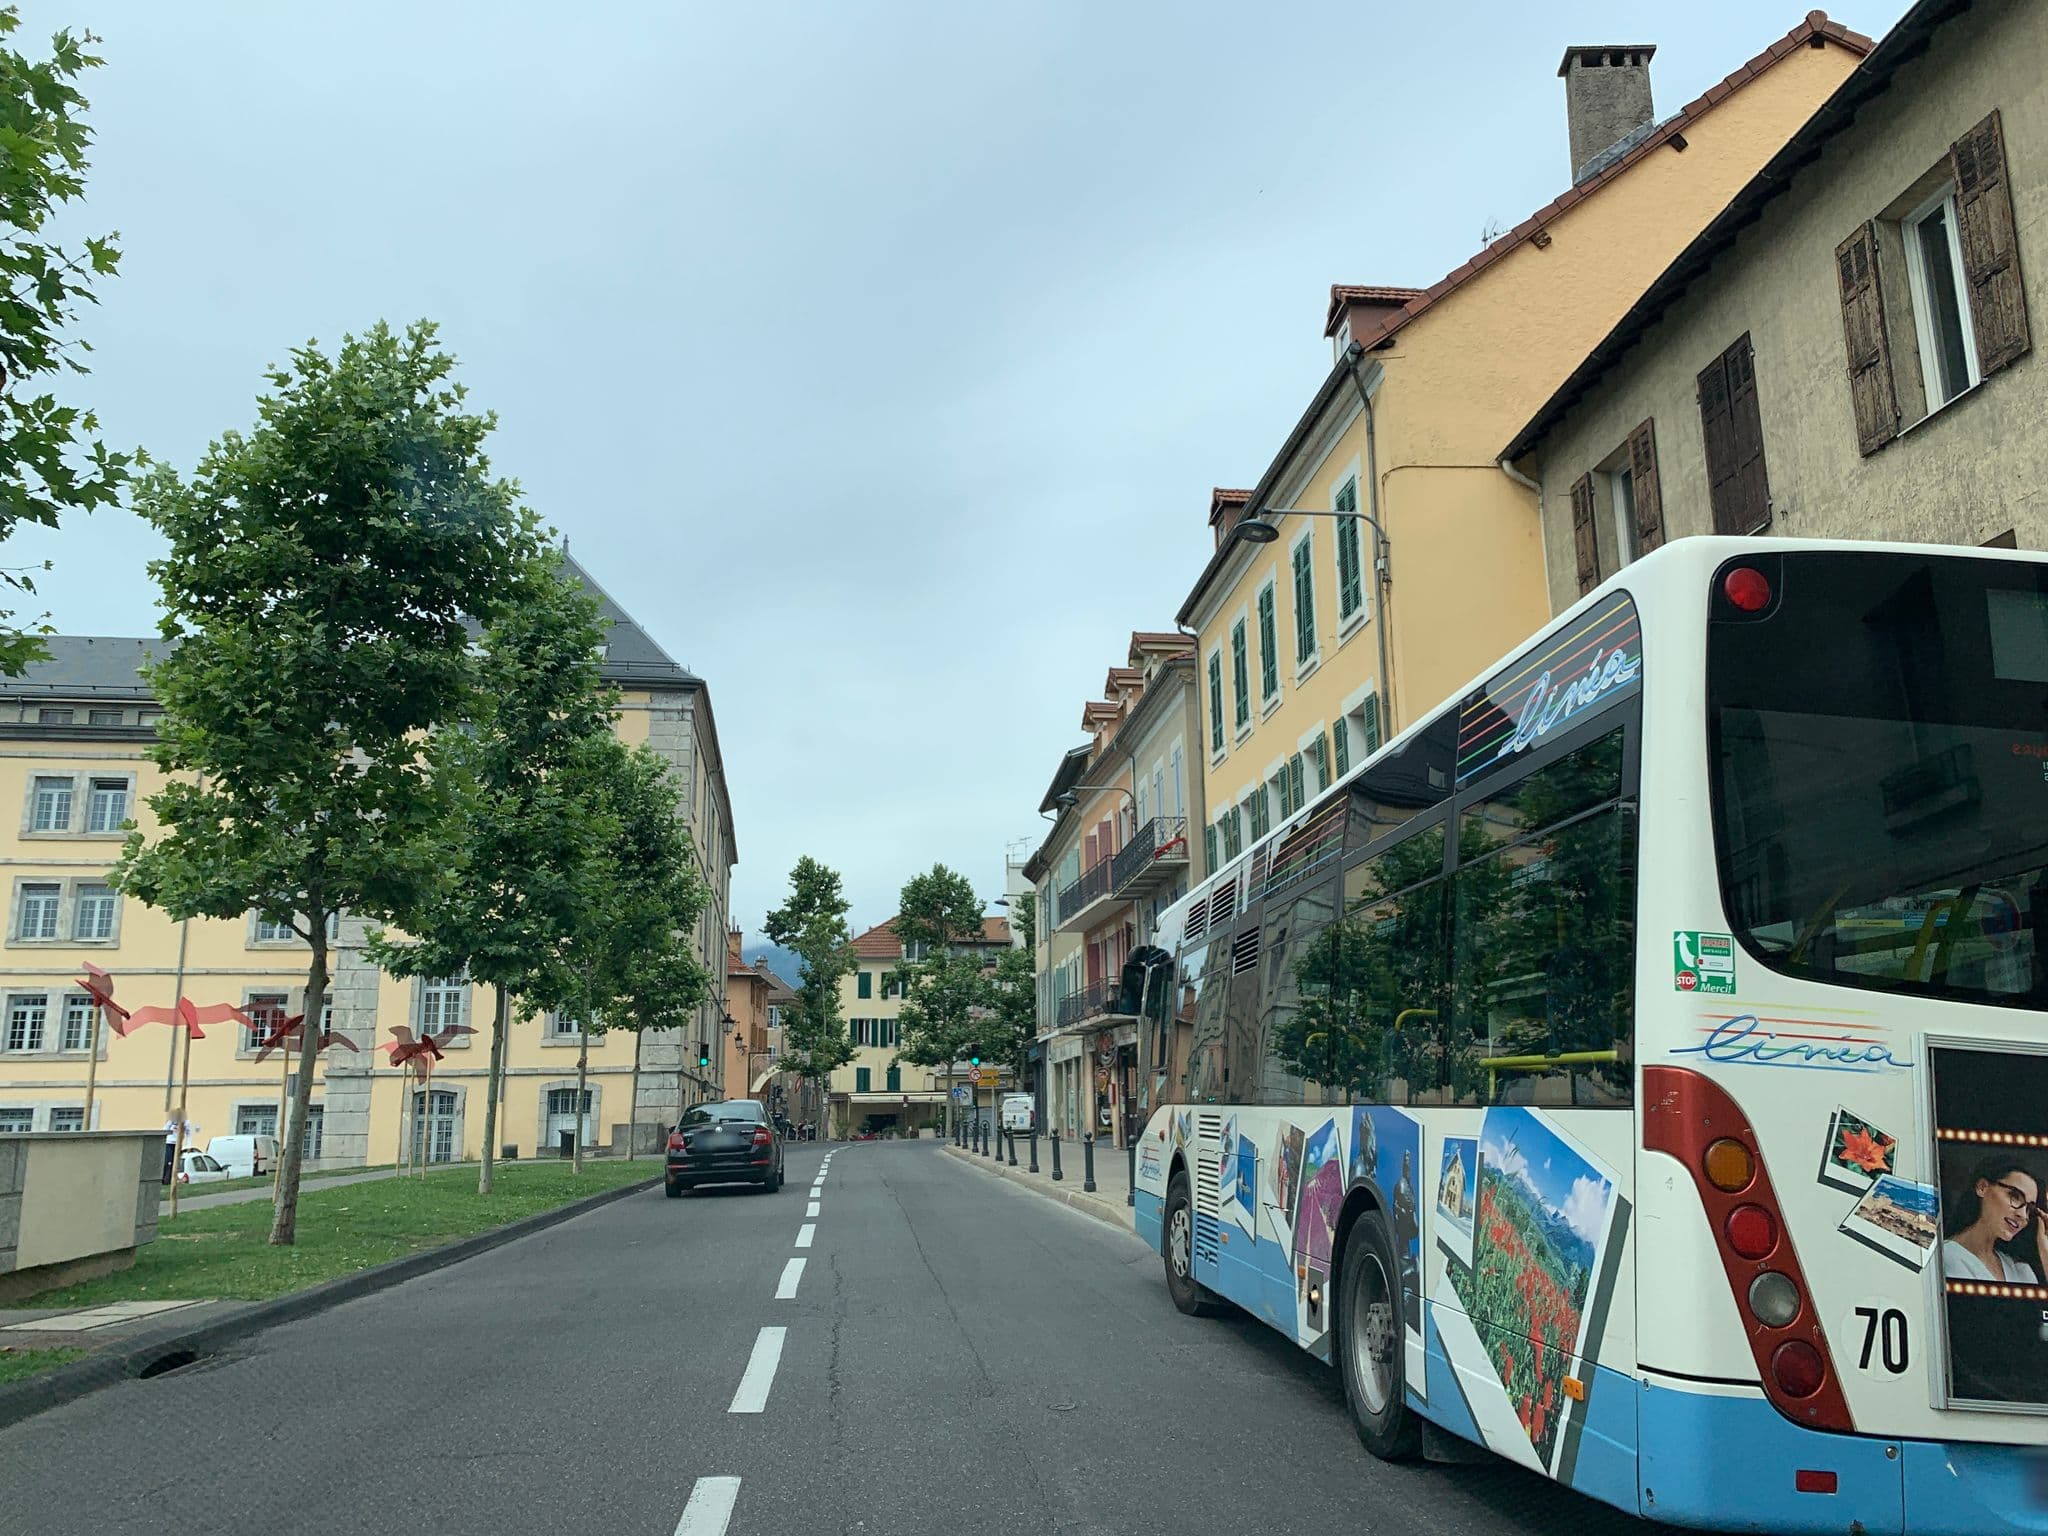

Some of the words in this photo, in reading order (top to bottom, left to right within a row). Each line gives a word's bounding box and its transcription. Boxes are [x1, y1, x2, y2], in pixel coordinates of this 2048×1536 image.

[1676, 976, 1697, 985] STOP
[1700, 983, 1732, 994] Merci!
[1855, 1306, 1909, 1374] 70
